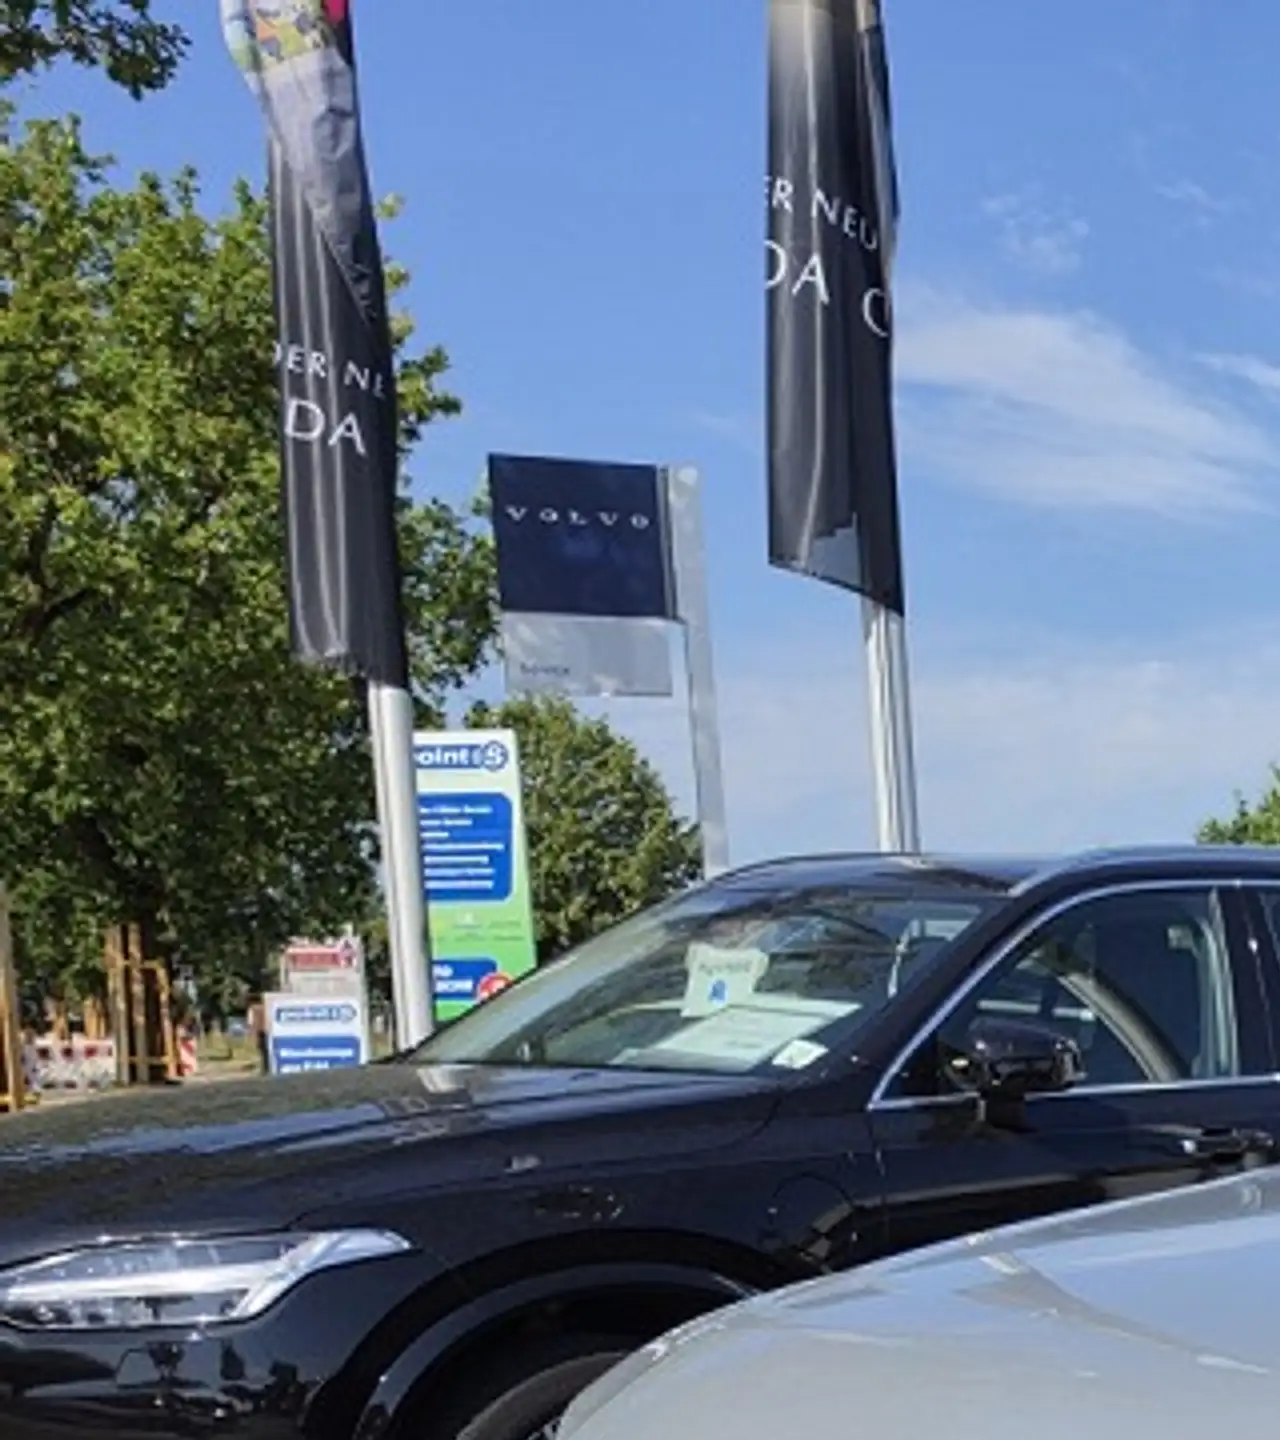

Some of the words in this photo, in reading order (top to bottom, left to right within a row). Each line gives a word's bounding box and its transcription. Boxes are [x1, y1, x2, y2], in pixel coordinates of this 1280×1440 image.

[283, 396, 369, 458] DA
[505, 504, 651, 530] VOLVO
[413, 747, 470, 766] oint
